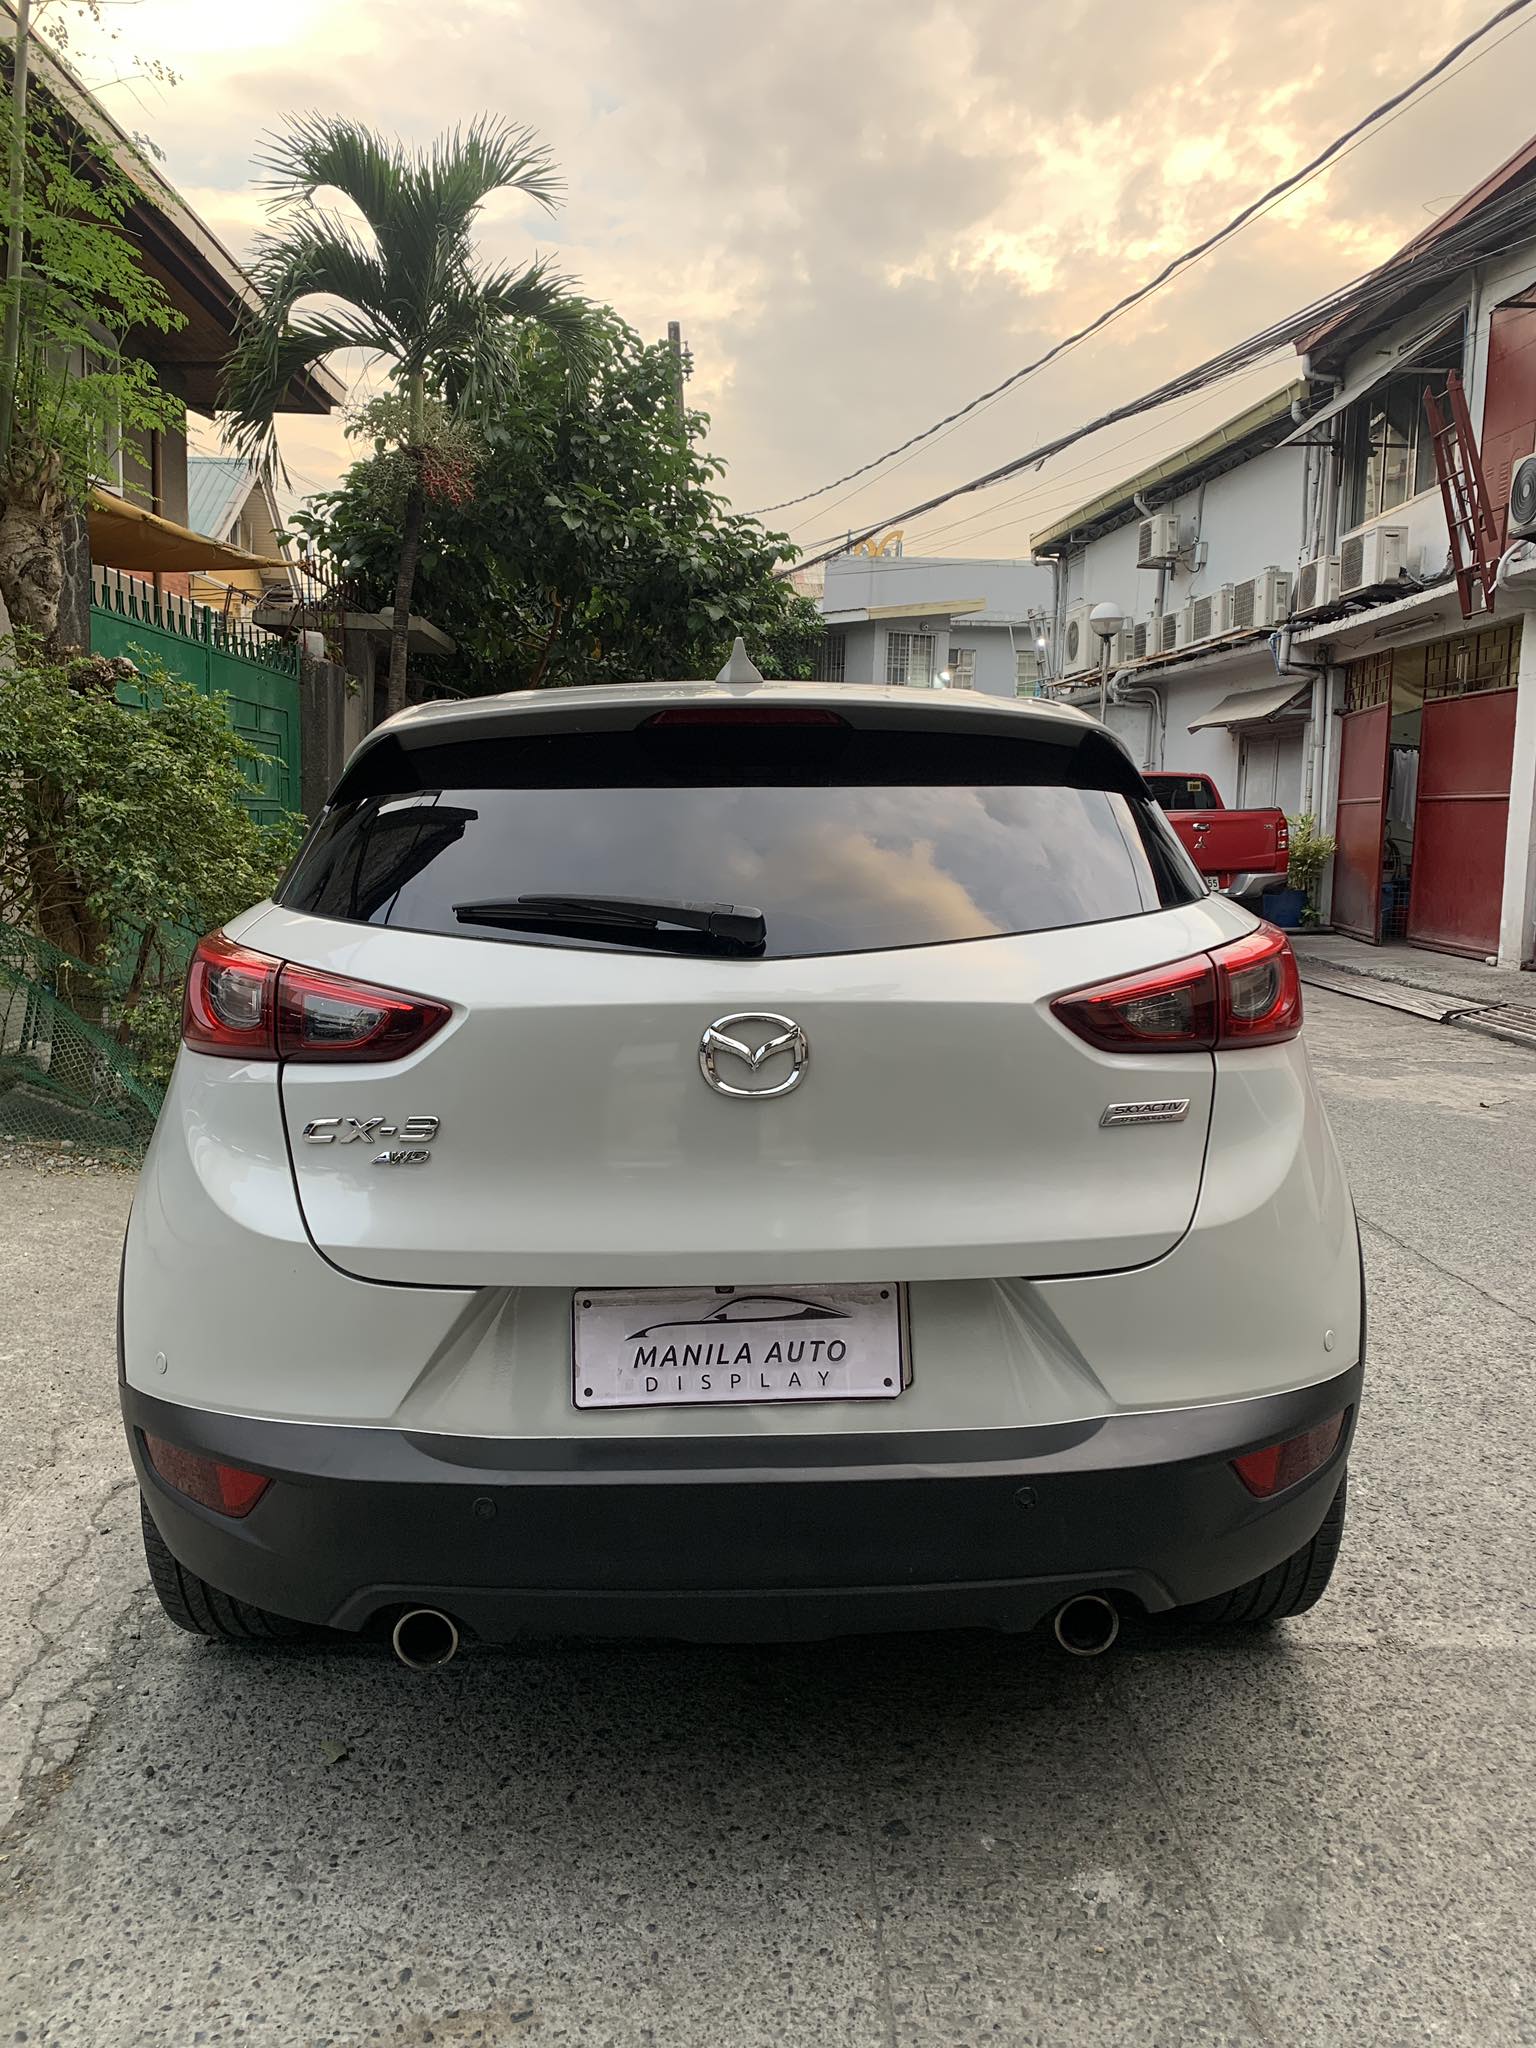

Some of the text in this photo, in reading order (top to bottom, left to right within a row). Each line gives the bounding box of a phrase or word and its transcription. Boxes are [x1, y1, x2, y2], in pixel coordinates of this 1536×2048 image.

[1113, 1102, 1183, 1115] SKYACTIV
[302, 1115, 440, 1144] CX-3
[370, 1150, 430, 1165] AWD
[633, 1340, 847, 1368] MANILA AUTO
[645, 1371, 829, 1392] DISPLAY
